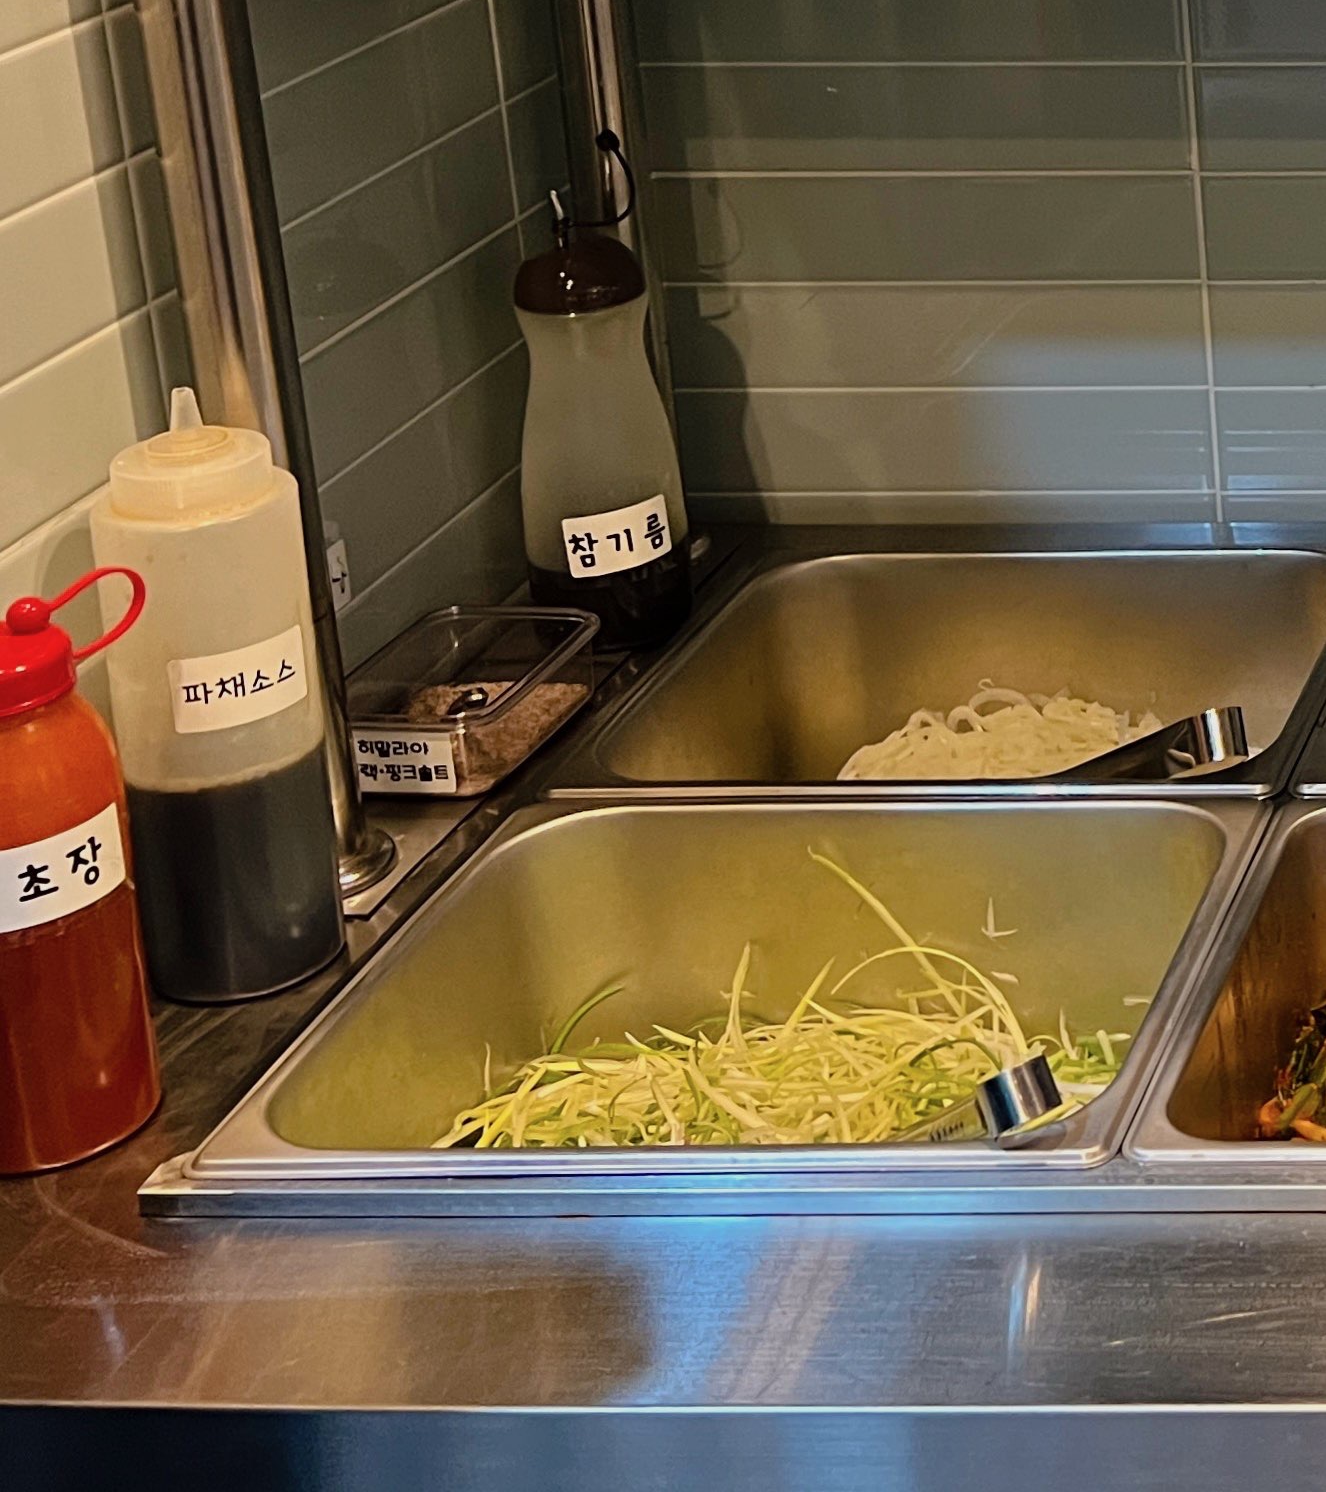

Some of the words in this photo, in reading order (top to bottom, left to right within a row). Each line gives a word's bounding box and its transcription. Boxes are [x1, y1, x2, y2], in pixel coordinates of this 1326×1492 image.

[568, 513, 666, 568] 참기름
[181, 658, 296, 704] 파채소스
[17, 836, 102, 902] 초장
